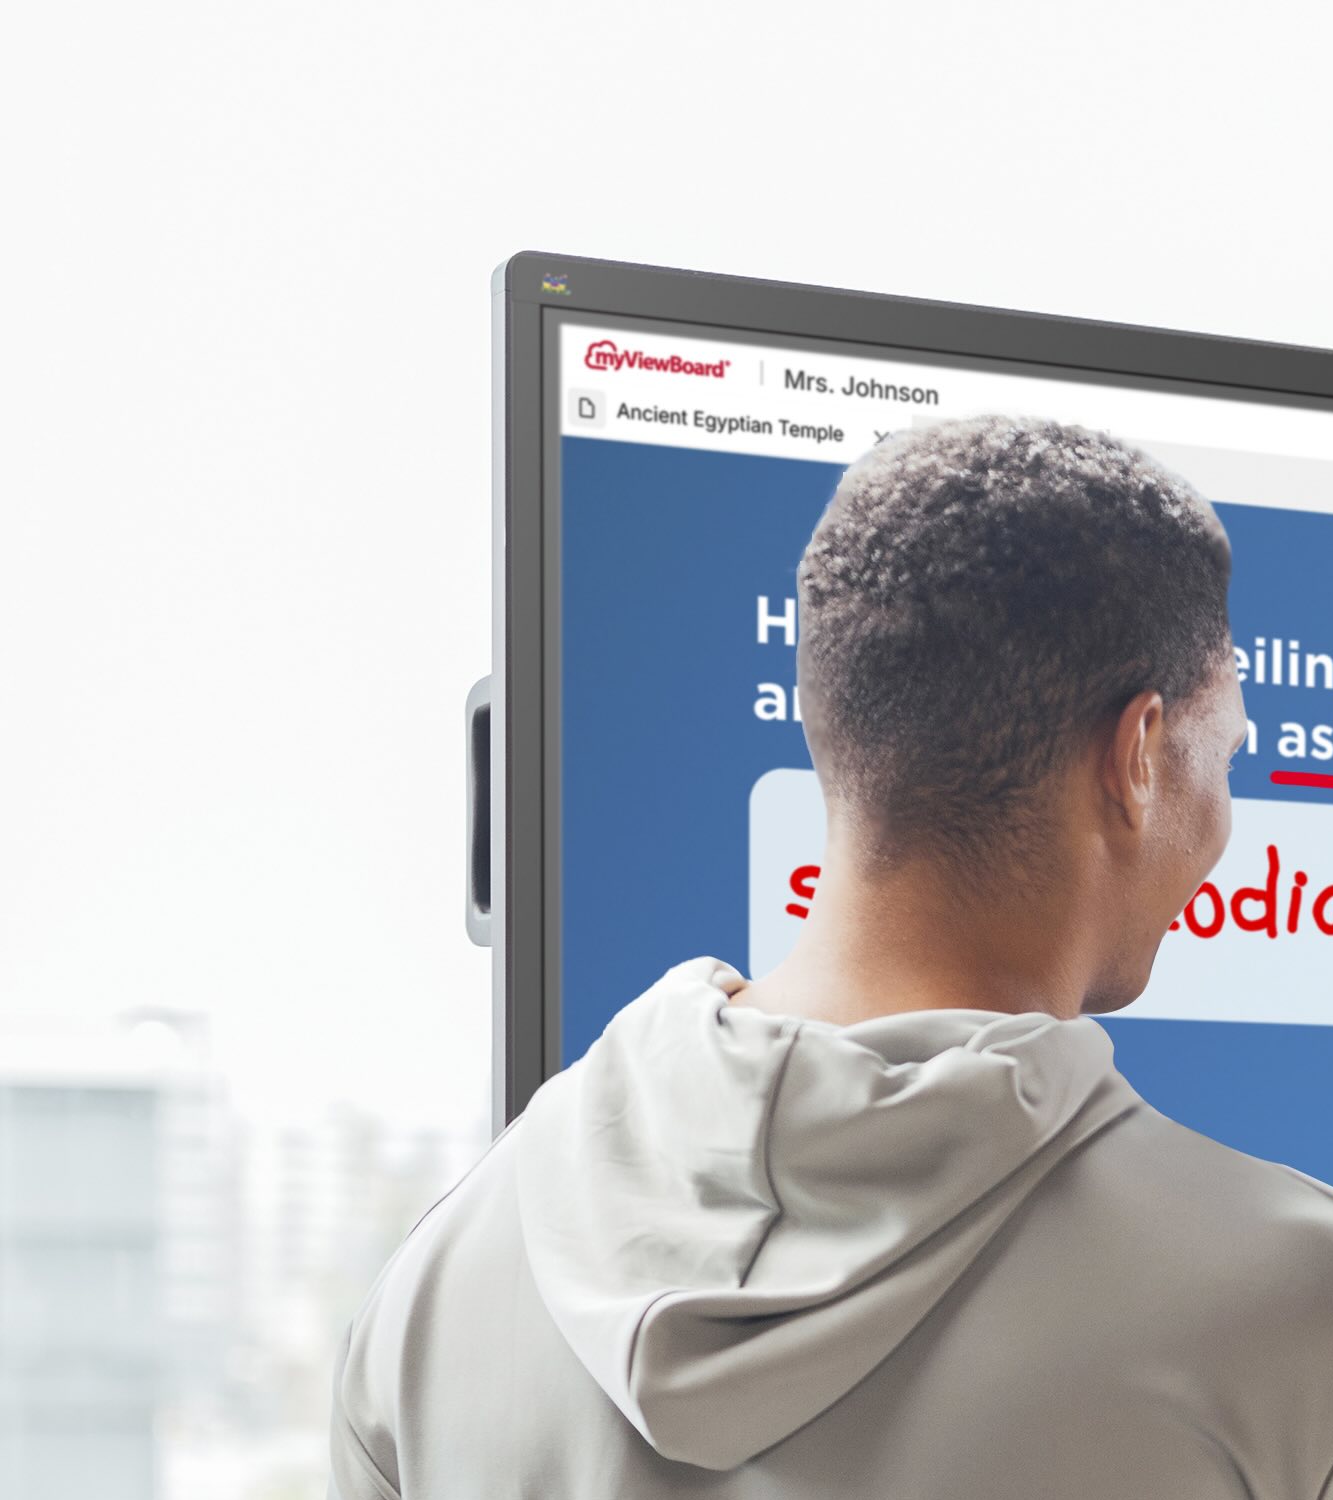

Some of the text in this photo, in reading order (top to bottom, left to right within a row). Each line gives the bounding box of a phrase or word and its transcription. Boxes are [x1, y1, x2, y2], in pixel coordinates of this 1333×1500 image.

[785, 368, 939, 405] Mrs. Johnson
[617, 402, 844, 443] Ancient Egyptian Temple
